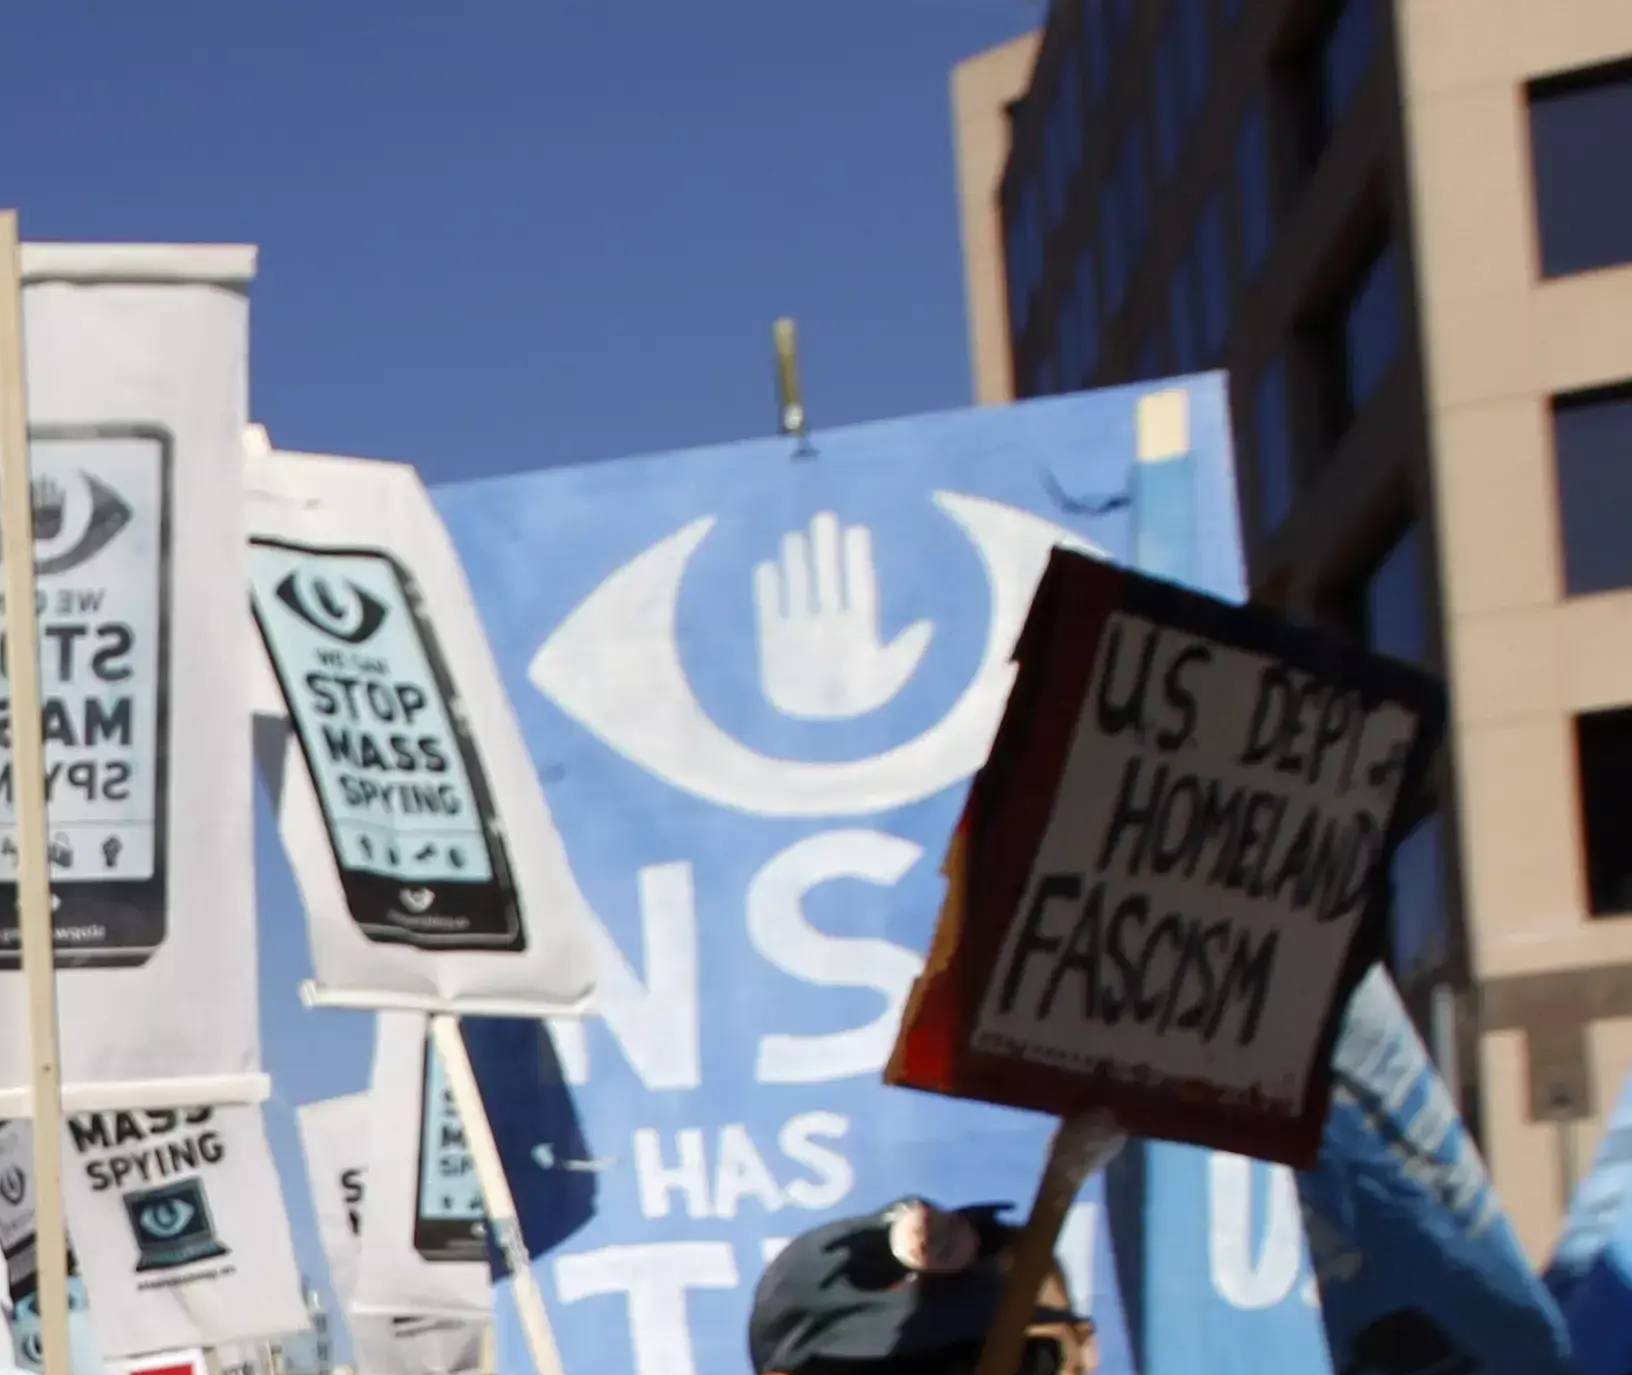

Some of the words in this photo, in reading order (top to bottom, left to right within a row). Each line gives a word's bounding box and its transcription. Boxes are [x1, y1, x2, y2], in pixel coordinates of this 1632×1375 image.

[305, 673, 427, 726] STOP
[322, 724, 447, 773] MASS
[339, 774, 461, 815] SPYING
[1097, 756, 1380, 921] HOMELAND
[548, 829, 928, 1089] NS
[999, 871, 1279, 1044] FASCISM
[86, 1131, 225, 1191] SPYING
[633, 1112, 852, 1220] HAS
